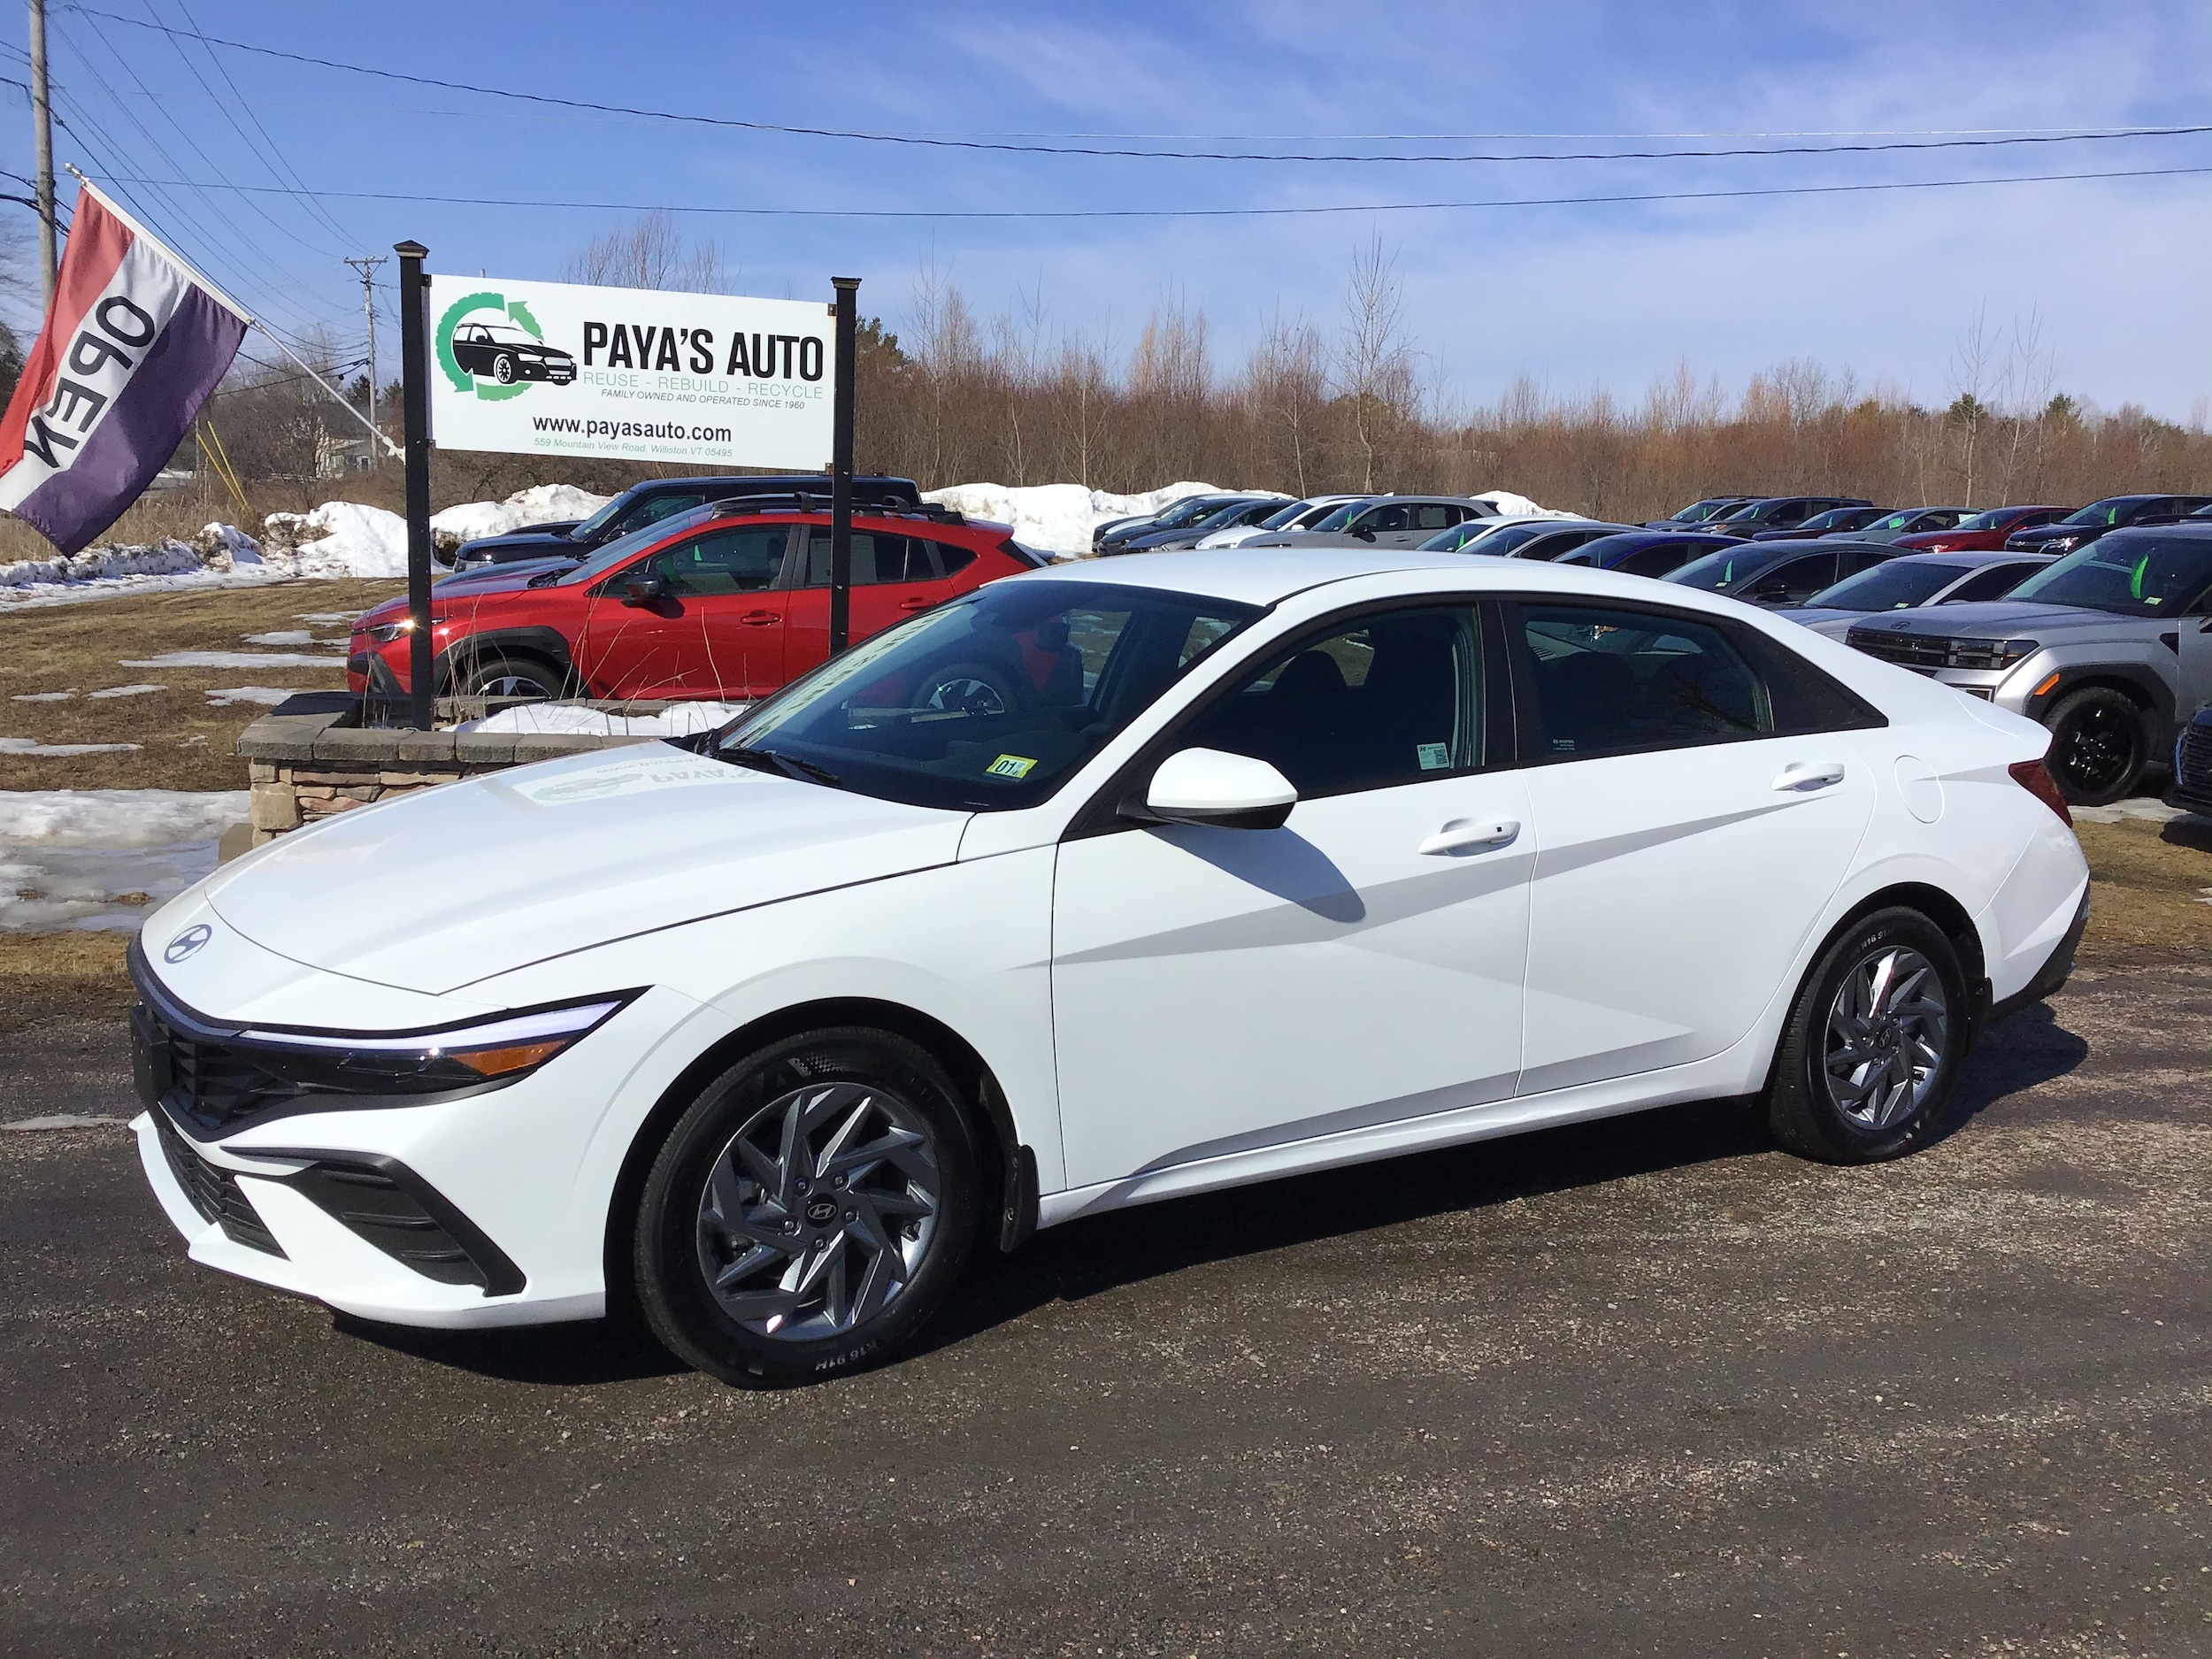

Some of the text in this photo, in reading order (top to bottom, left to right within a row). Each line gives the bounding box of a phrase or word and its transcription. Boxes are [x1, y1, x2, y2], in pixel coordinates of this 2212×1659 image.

[584, 321, 823, 381] PAYA'S AUTO
[583, 372, 639, 388] REUSE
[658, 376, 729, 394] REBUILD
[749, 382, 823, 399] RECYCLE
[601, 388, 806, 411] FAMILY OWNED AND OPERATED SINCE 1960
[533, 416, 733, 442] www.payasauto.com
[534, 437, 551, 448] 559
[553, 438, 596, 449] Mountain
[597, 441, 620, 451] View
[651, 443, 688, 456] Williston
[689, 446, 703, 457] VT
[704, 447, 733, 458] 05495
[995, 760, 1017, 774] 01
